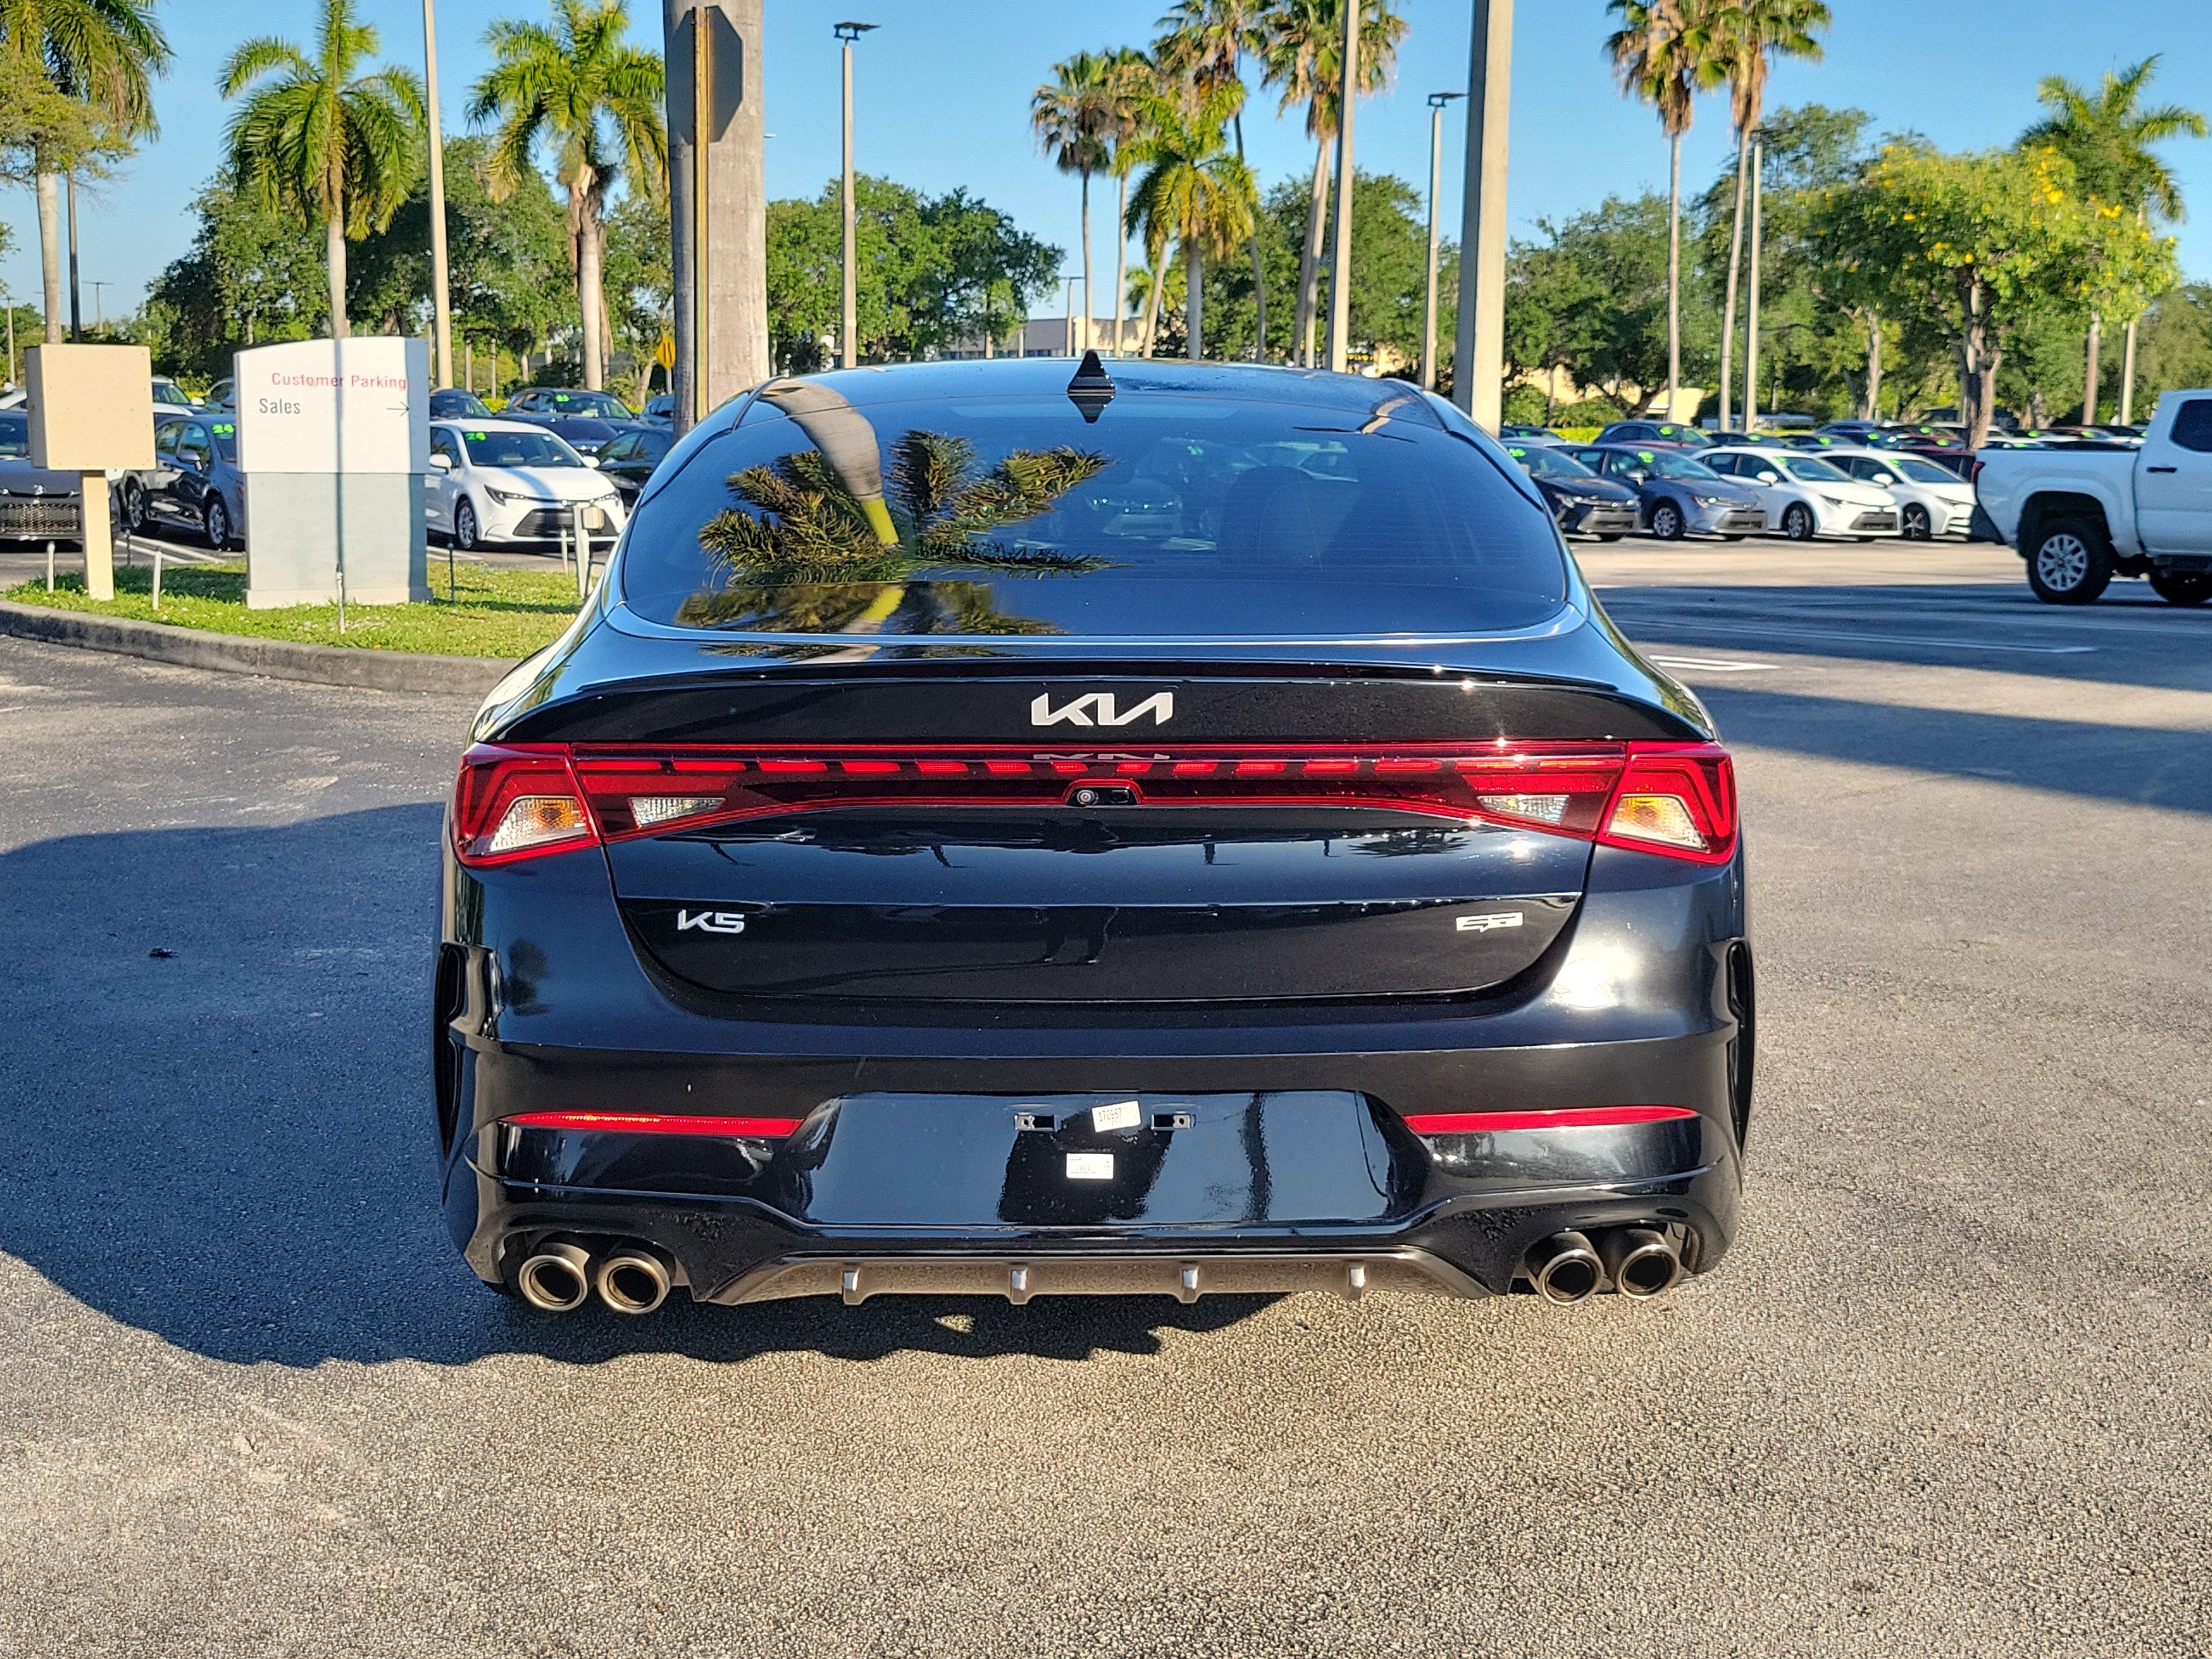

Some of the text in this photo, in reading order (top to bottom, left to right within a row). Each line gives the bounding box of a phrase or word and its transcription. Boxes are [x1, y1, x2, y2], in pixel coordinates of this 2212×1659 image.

[272, 373, 407, 391] Customer Parking
[259, 398, 301, 414] Sales
[1031, 692, 1173, 726] KIA
[678, 909, 745, 934] K5
